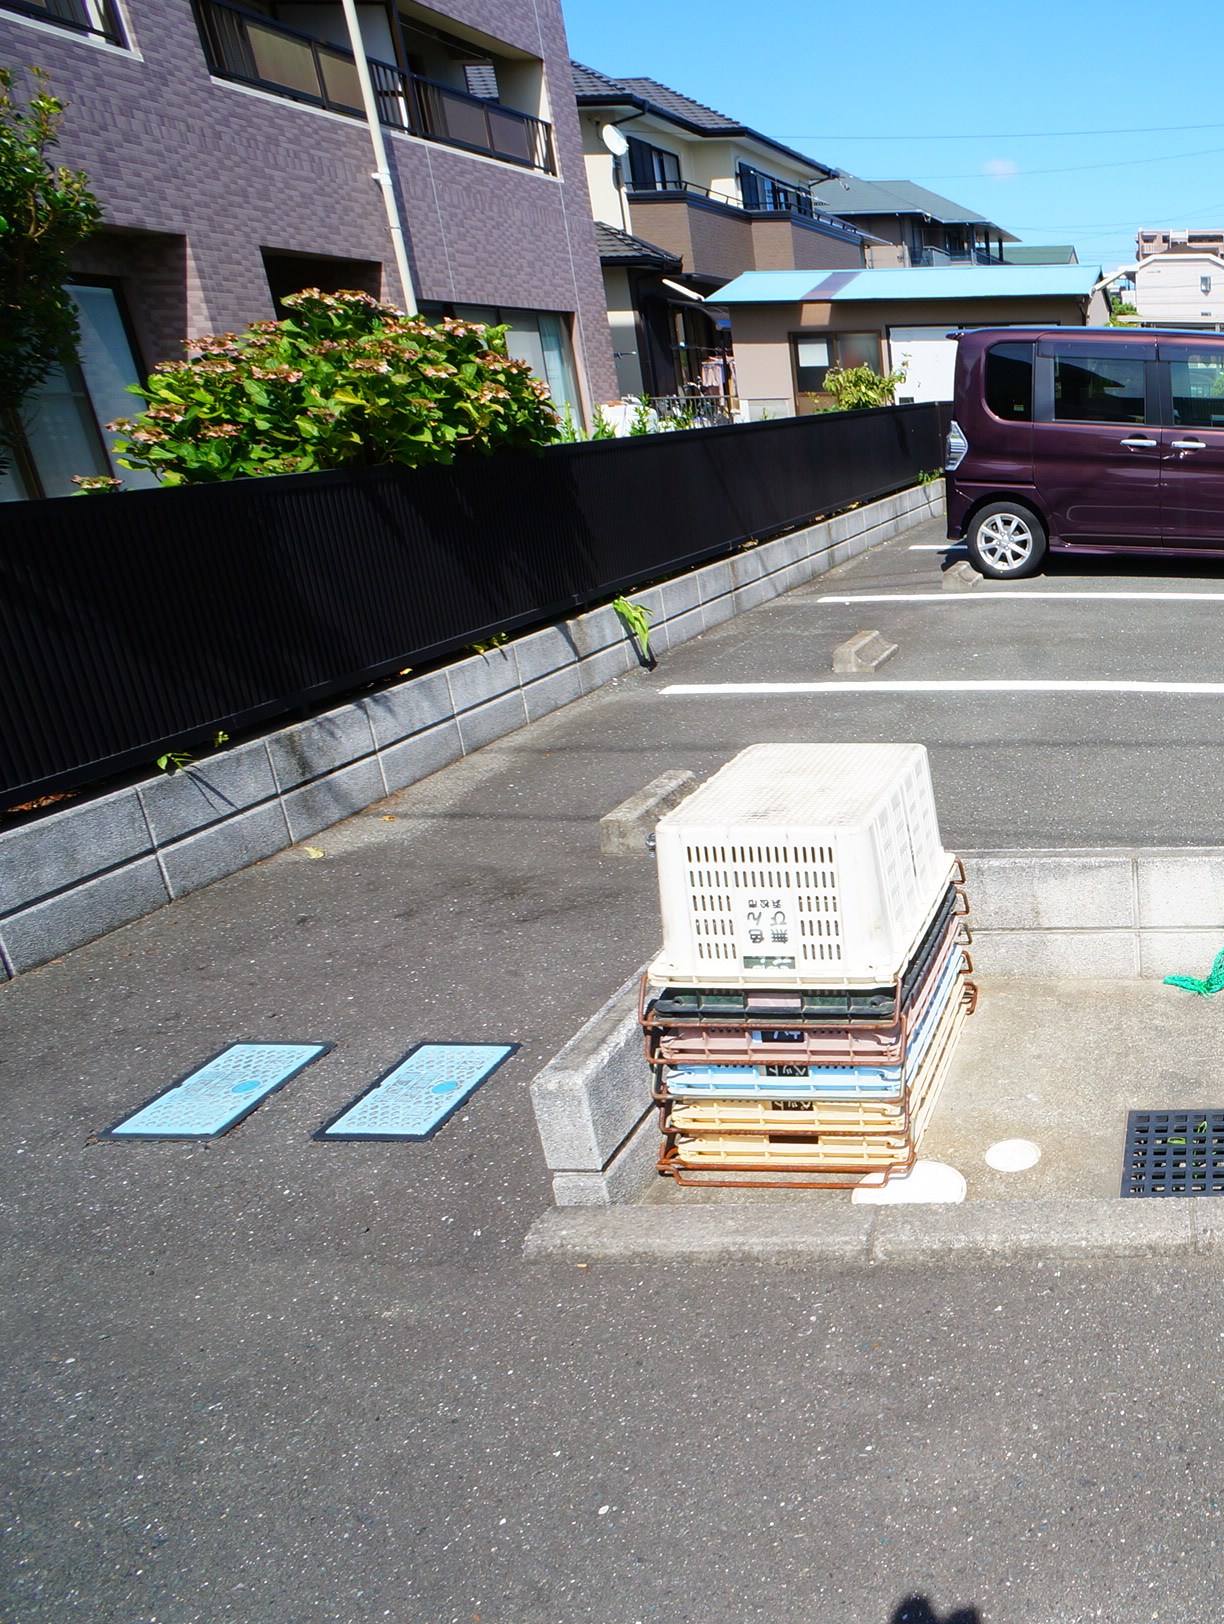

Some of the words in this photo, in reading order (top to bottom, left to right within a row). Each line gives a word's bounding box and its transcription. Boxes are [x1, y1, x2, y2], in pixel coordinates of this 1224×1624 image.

[747, 911, 788, 927] びん
[748, 928, 789, 944] 無色
[768, 1065, 807, 1077] ペット
